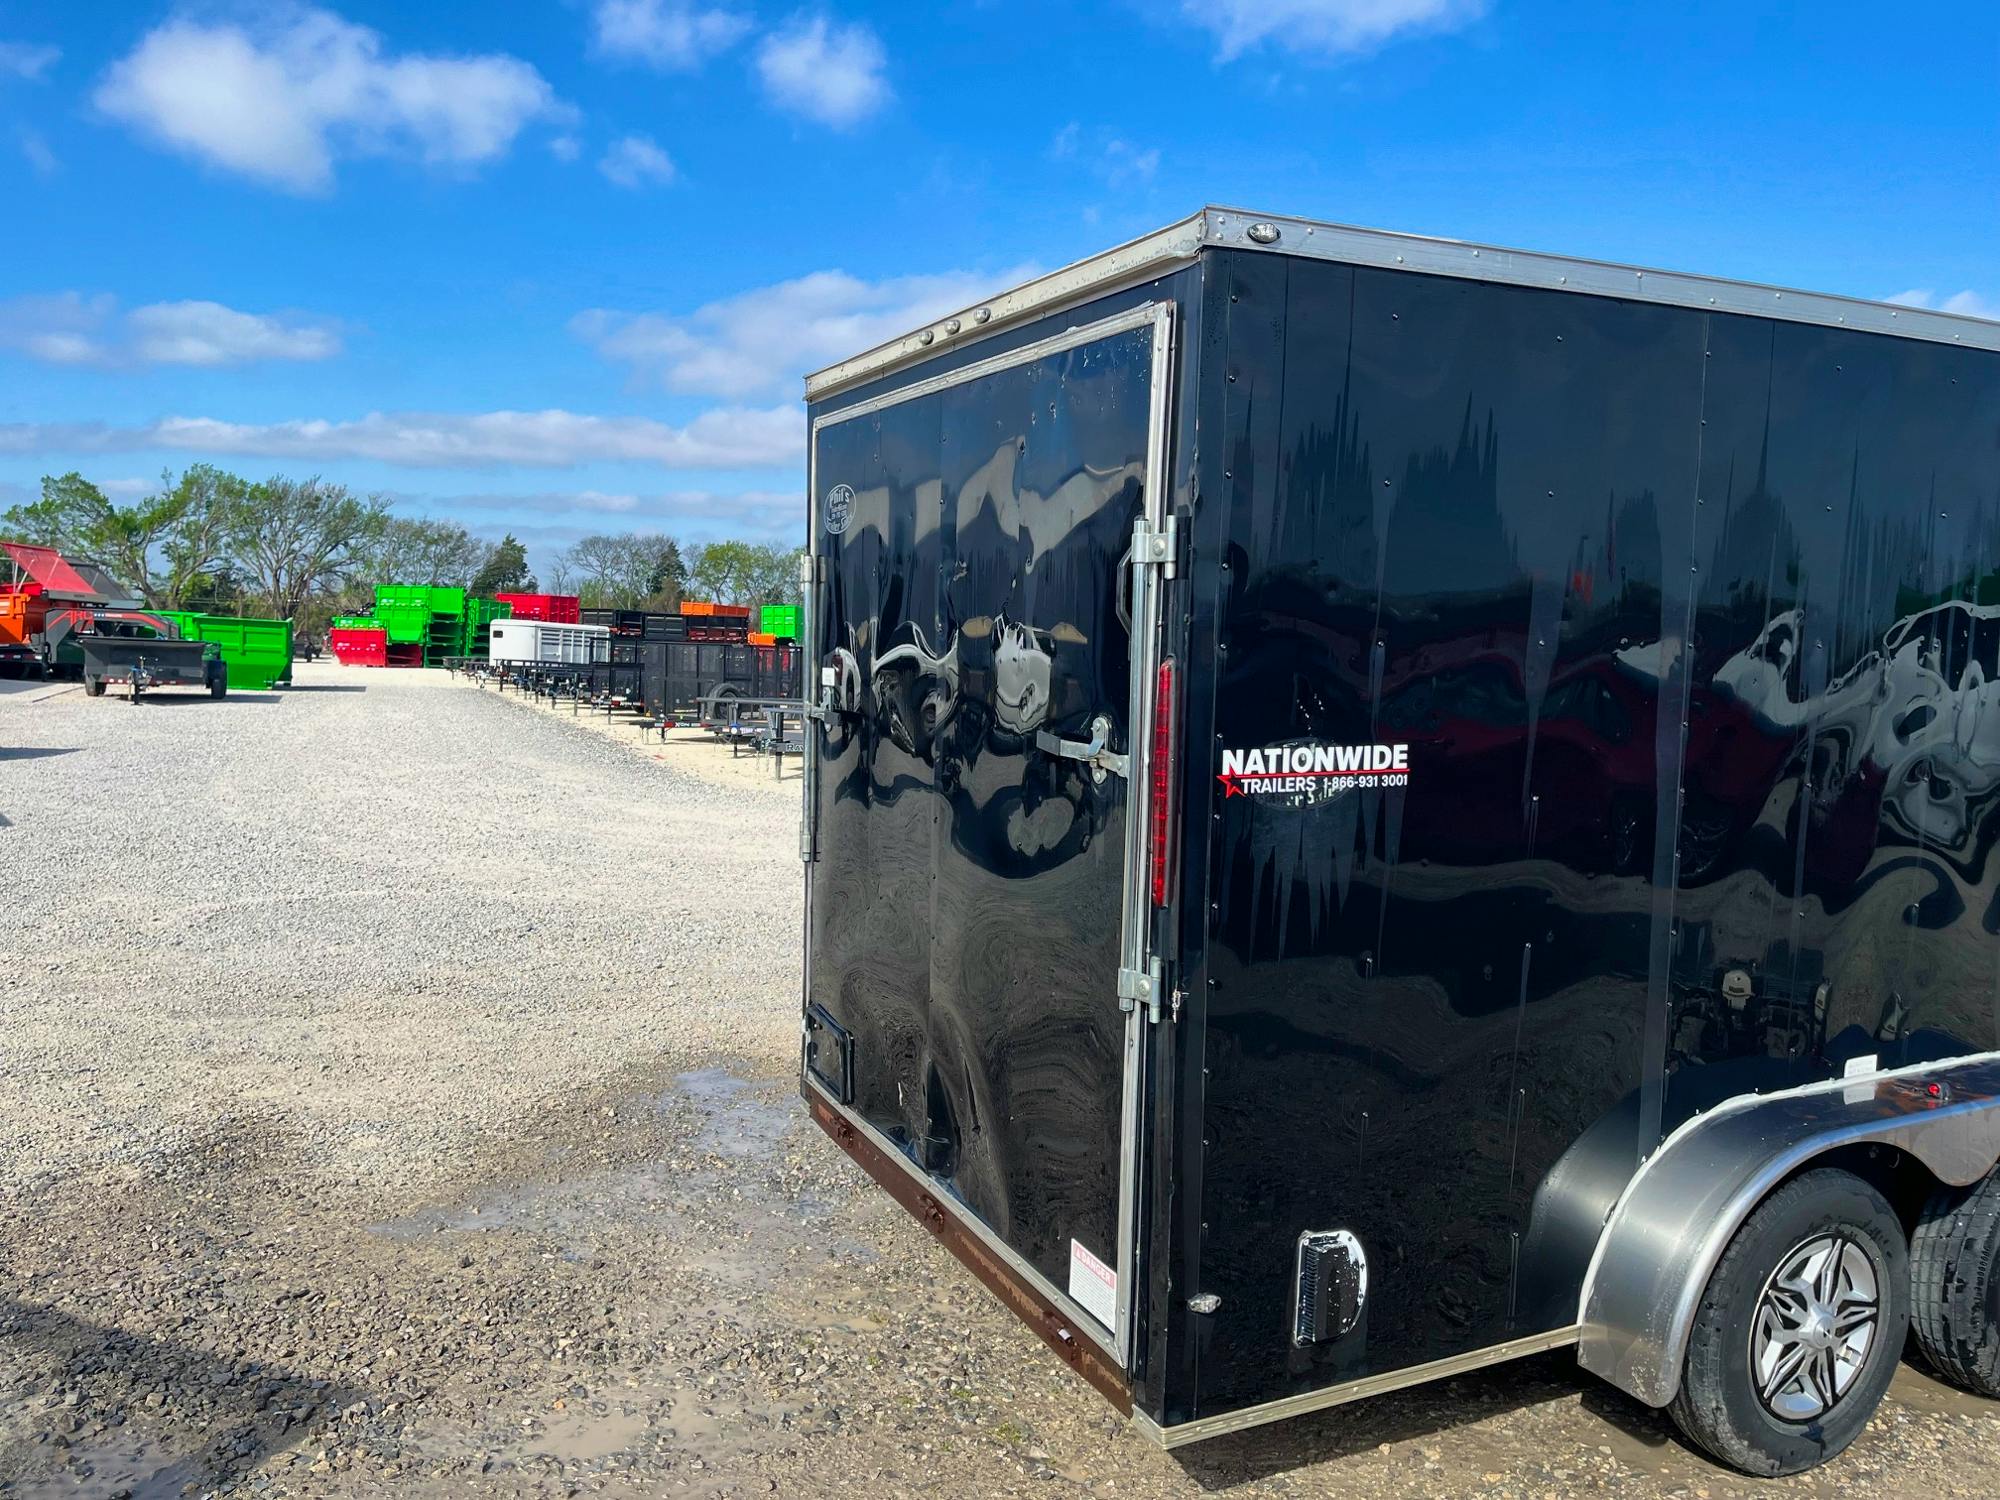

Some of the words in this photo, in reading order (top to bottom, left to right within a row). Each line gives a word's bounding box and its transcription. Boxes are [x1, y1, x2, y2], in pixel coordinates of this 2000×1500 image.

[1222, 744, 1408, 776] NATIONWIDE
[1241, 777, 1316, 794] TRAILERS
[1323, 775, 1378, 789] 1-866-931
[1381, 774, 1408, 787] 3001
[1081, 1252, 1111, 1284] DANGER
